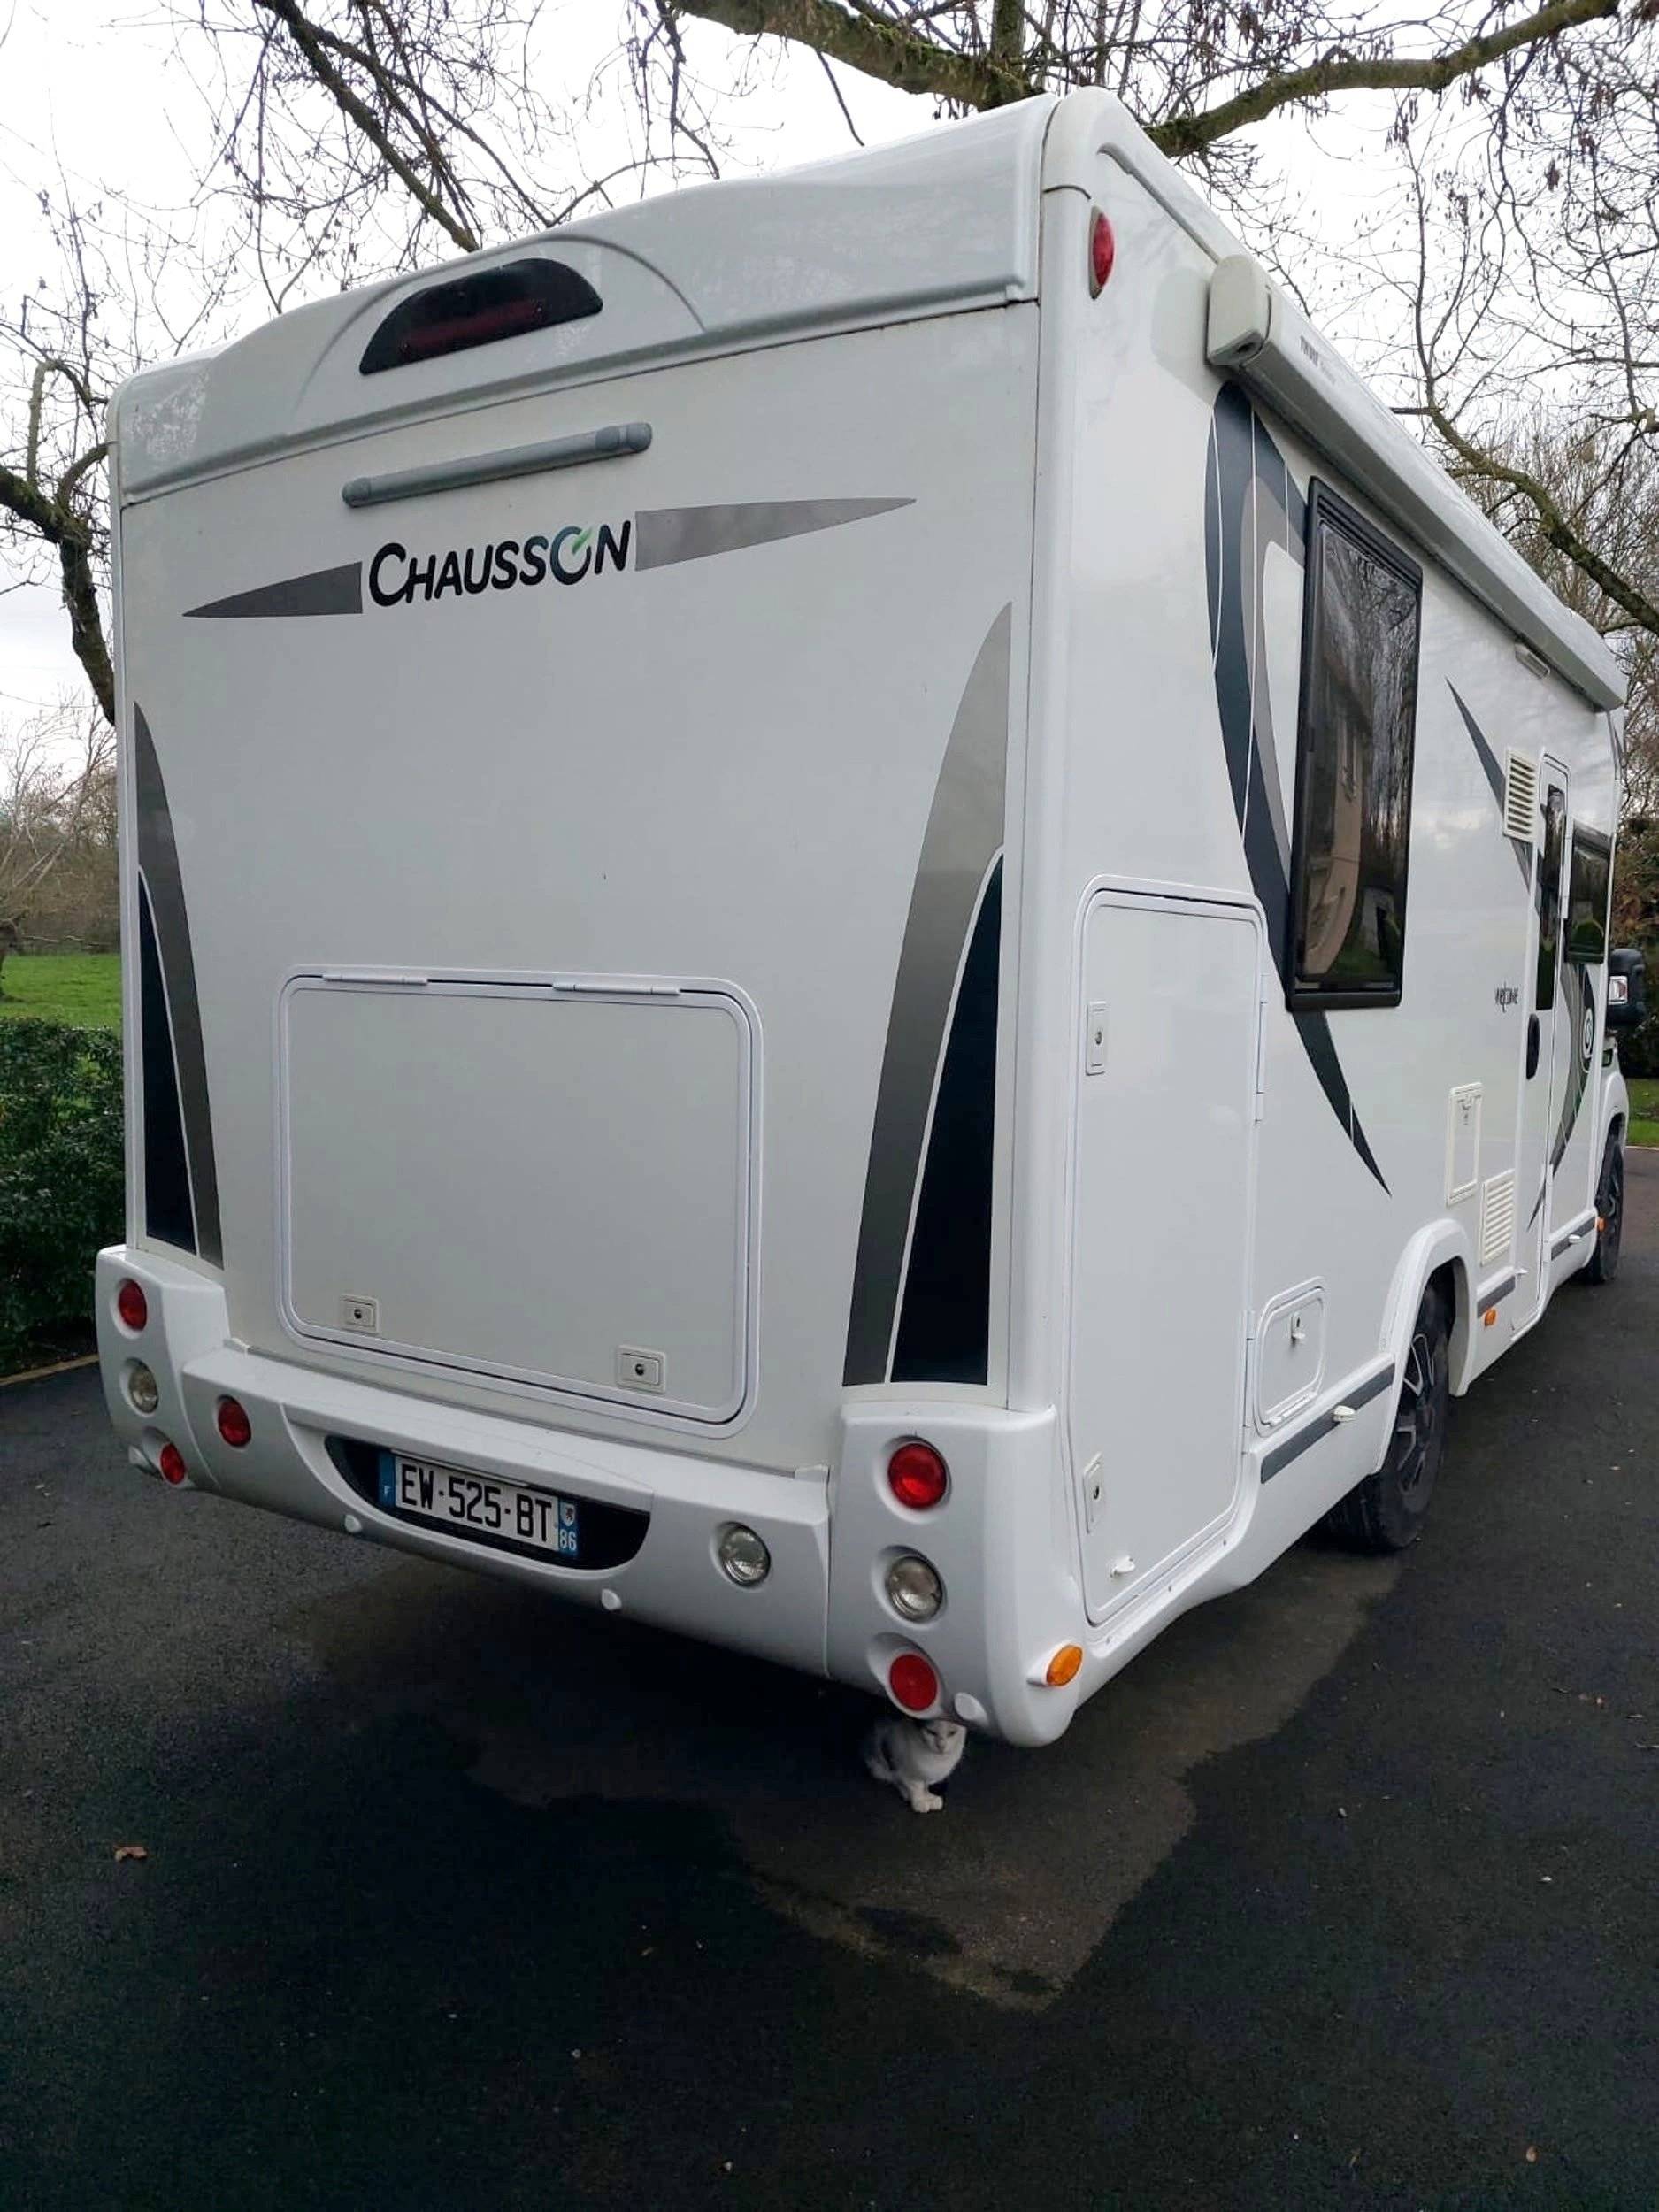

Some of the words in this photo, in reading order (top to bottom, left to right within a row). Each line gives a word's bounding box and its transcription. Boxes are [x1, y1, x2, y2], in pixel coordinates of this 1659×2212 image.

[369, 520, 631, 606] CHAUSSON
[402, 1463, 552, 1542] EW-525-BT
[559, 1529, 576, 1551] 86
